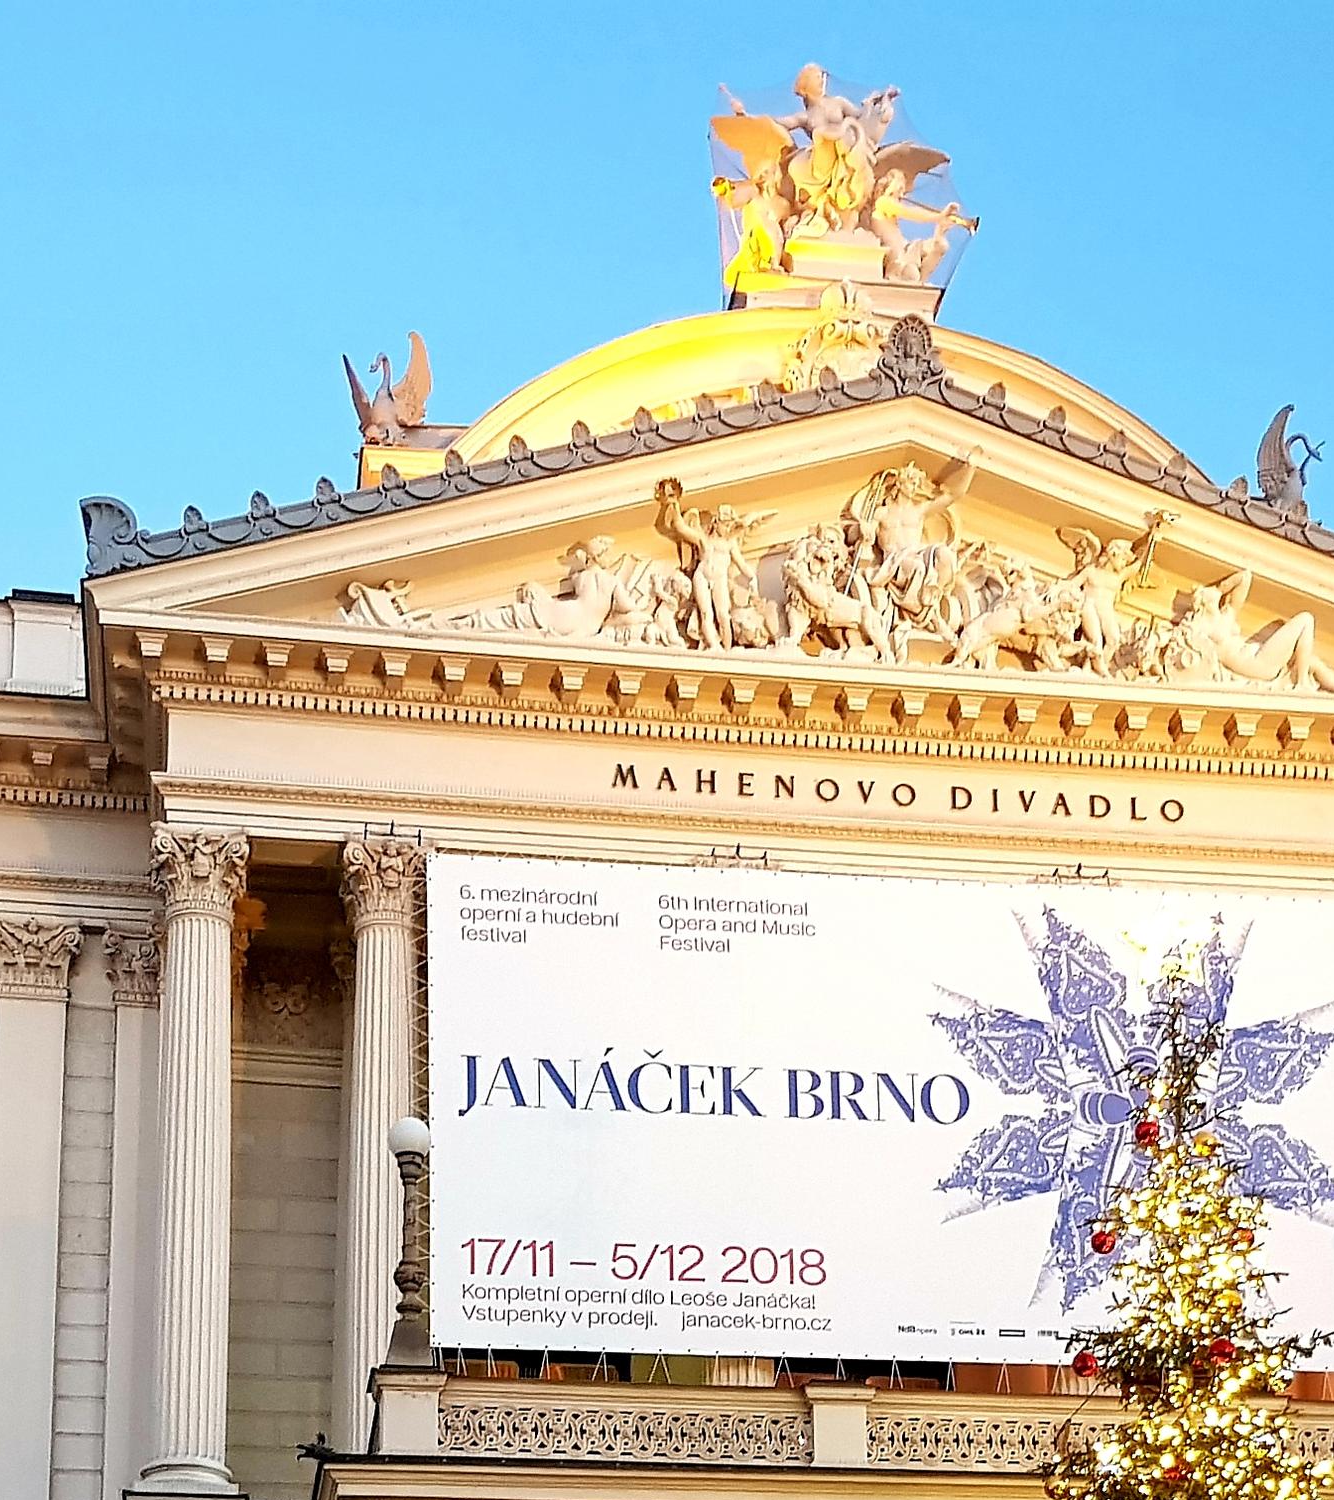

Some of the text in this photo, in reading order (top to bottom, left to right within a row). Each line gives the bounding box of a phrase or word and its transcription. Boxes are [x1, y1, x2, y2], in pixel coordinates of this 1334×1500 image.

[611, 763, 1185, 823] MAHENOVO DIVADLO
[459, 884, 598, 907] 6. mezinárodní
[658, 895, 808, 916] 6th International
[460, 908, 619, 928] operní a hudební
[658, 916, 816, 937] Opera and Music
[461, 928, 527, 943] festival
[660, 936, 730, 953] Festival
[458, 1047, 970, 1125] JANÁČEK BRNO
[461, 1238, 555, 1278] 17/11
[611, 1243, 706, 1281] 5/12
[721, 1246, 827, 1286] 2018
[461, 1283, 816, 1310] Kompletní operní dílo Leoše Janáčka!
[462, 1306, 831, 1332] Vstupenky v prodeji. janacek-brno.cz
